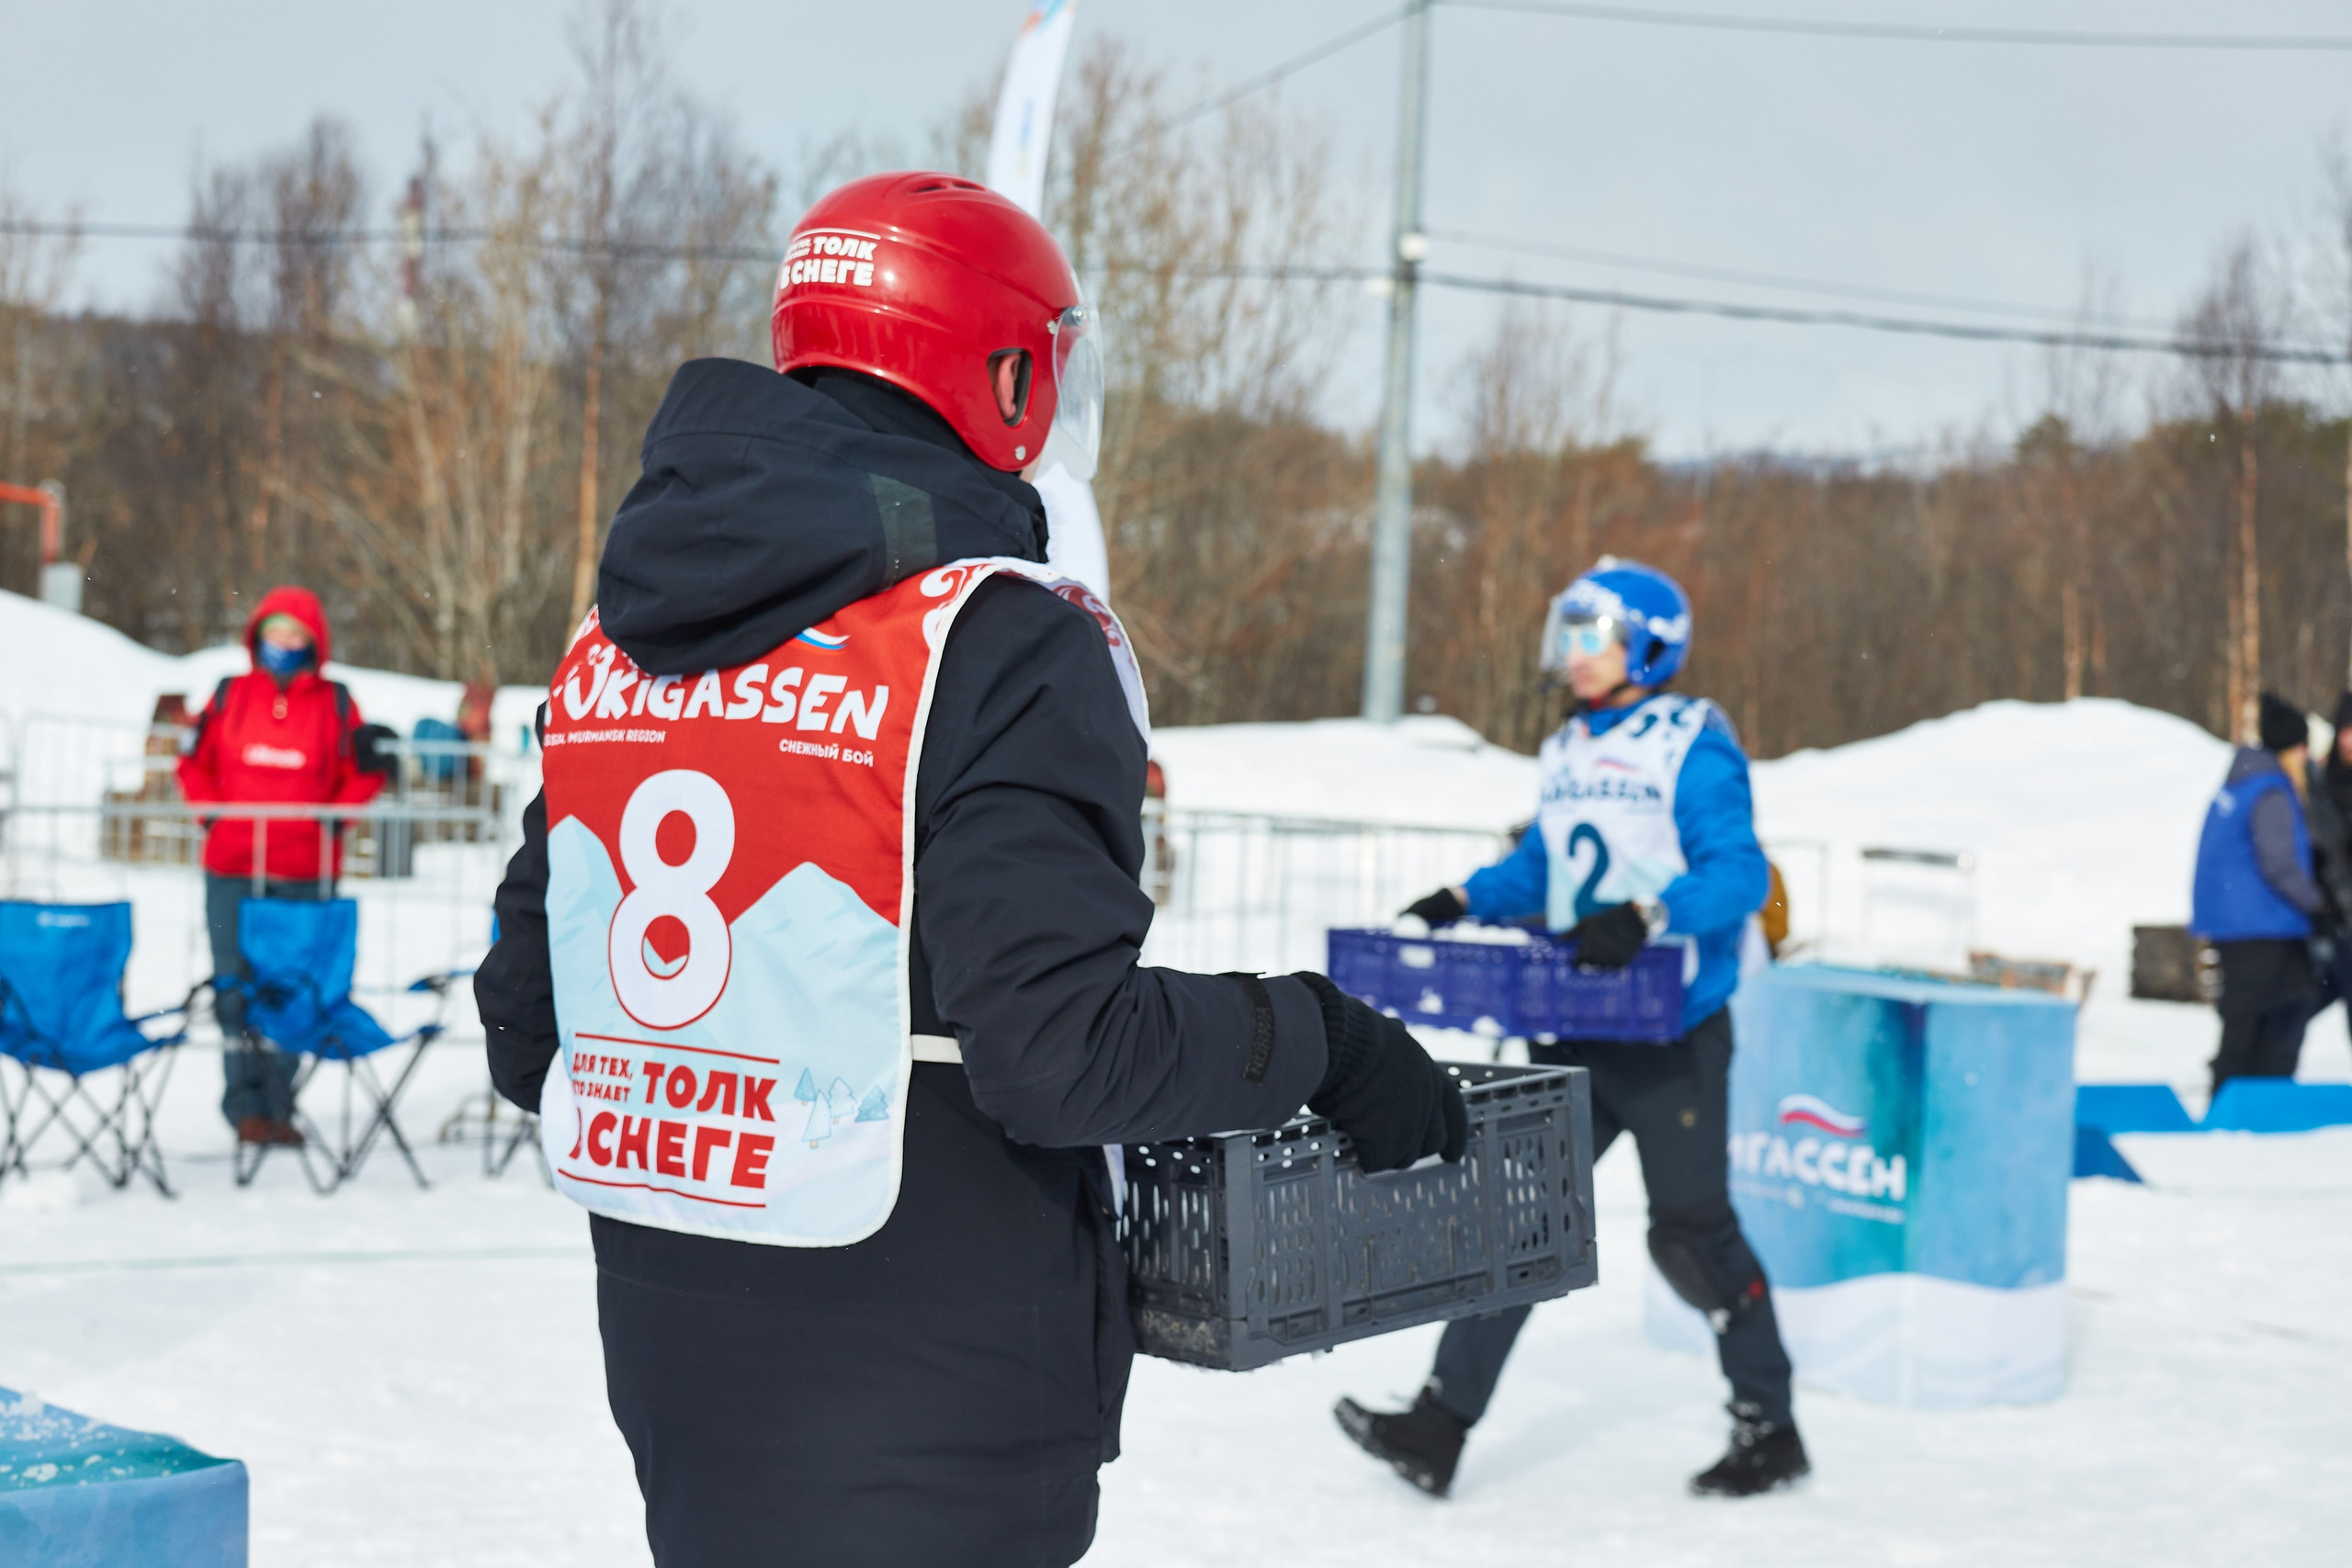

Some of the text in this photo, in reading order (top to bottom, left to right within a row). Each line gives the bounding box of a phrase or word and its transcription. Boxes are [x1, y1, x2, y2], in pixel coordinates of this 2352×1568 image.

[813, 236, 877, 261] ТОЛК
[791, 258, 875, 287] СНЕГЕ
[568, 729, 625, 743] MURMANSK
[626, 728, 666, 743] REGION
[779, 739, 874, 768] СНЕЖНЫЙ БОЙ
[1567, 823, 1633, 919] 2
[608, 768, 735, 1032] 8
[600, 1055, 633, 1081] ТЕХ,
[587, 1082, 630, 1103] ЗНАЕТ
[643, 1061, 779, 1122] ТОЛК
[587, 1110, 775, 1190] СНЕГЕ
